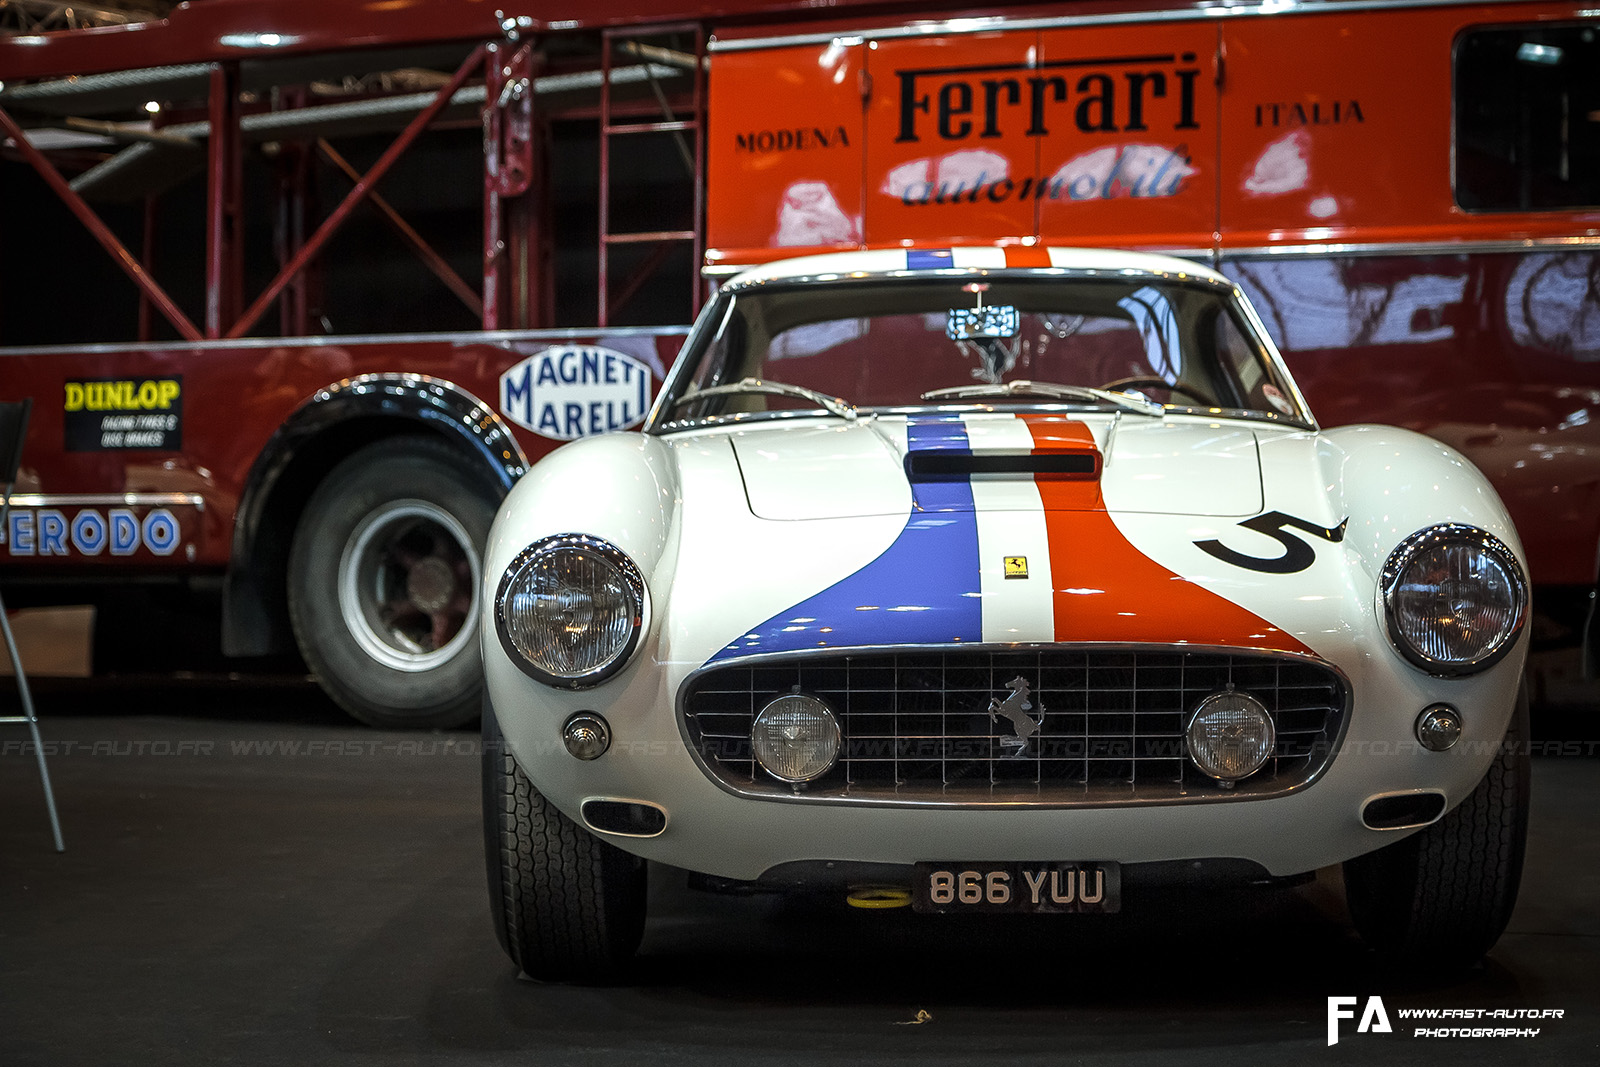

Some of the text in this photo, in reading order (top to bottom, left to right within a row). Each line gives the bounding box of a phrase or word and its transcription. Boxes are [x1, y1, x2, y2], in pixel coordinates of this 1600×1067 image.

[894, 51, 1200, 143] Ferrari
[1255, 100, 1364, 128] ITALIA
[735, 125, 850, 153] MODENA
[64, 380, 180, 412] DUNLOP
[505, 350, 645, 416] MAGNETI
[0, 508, 181, 557] ERODO
[1187, 510, 1350, 575] 5
[930, 871, 1103, 904] 866 YUU
